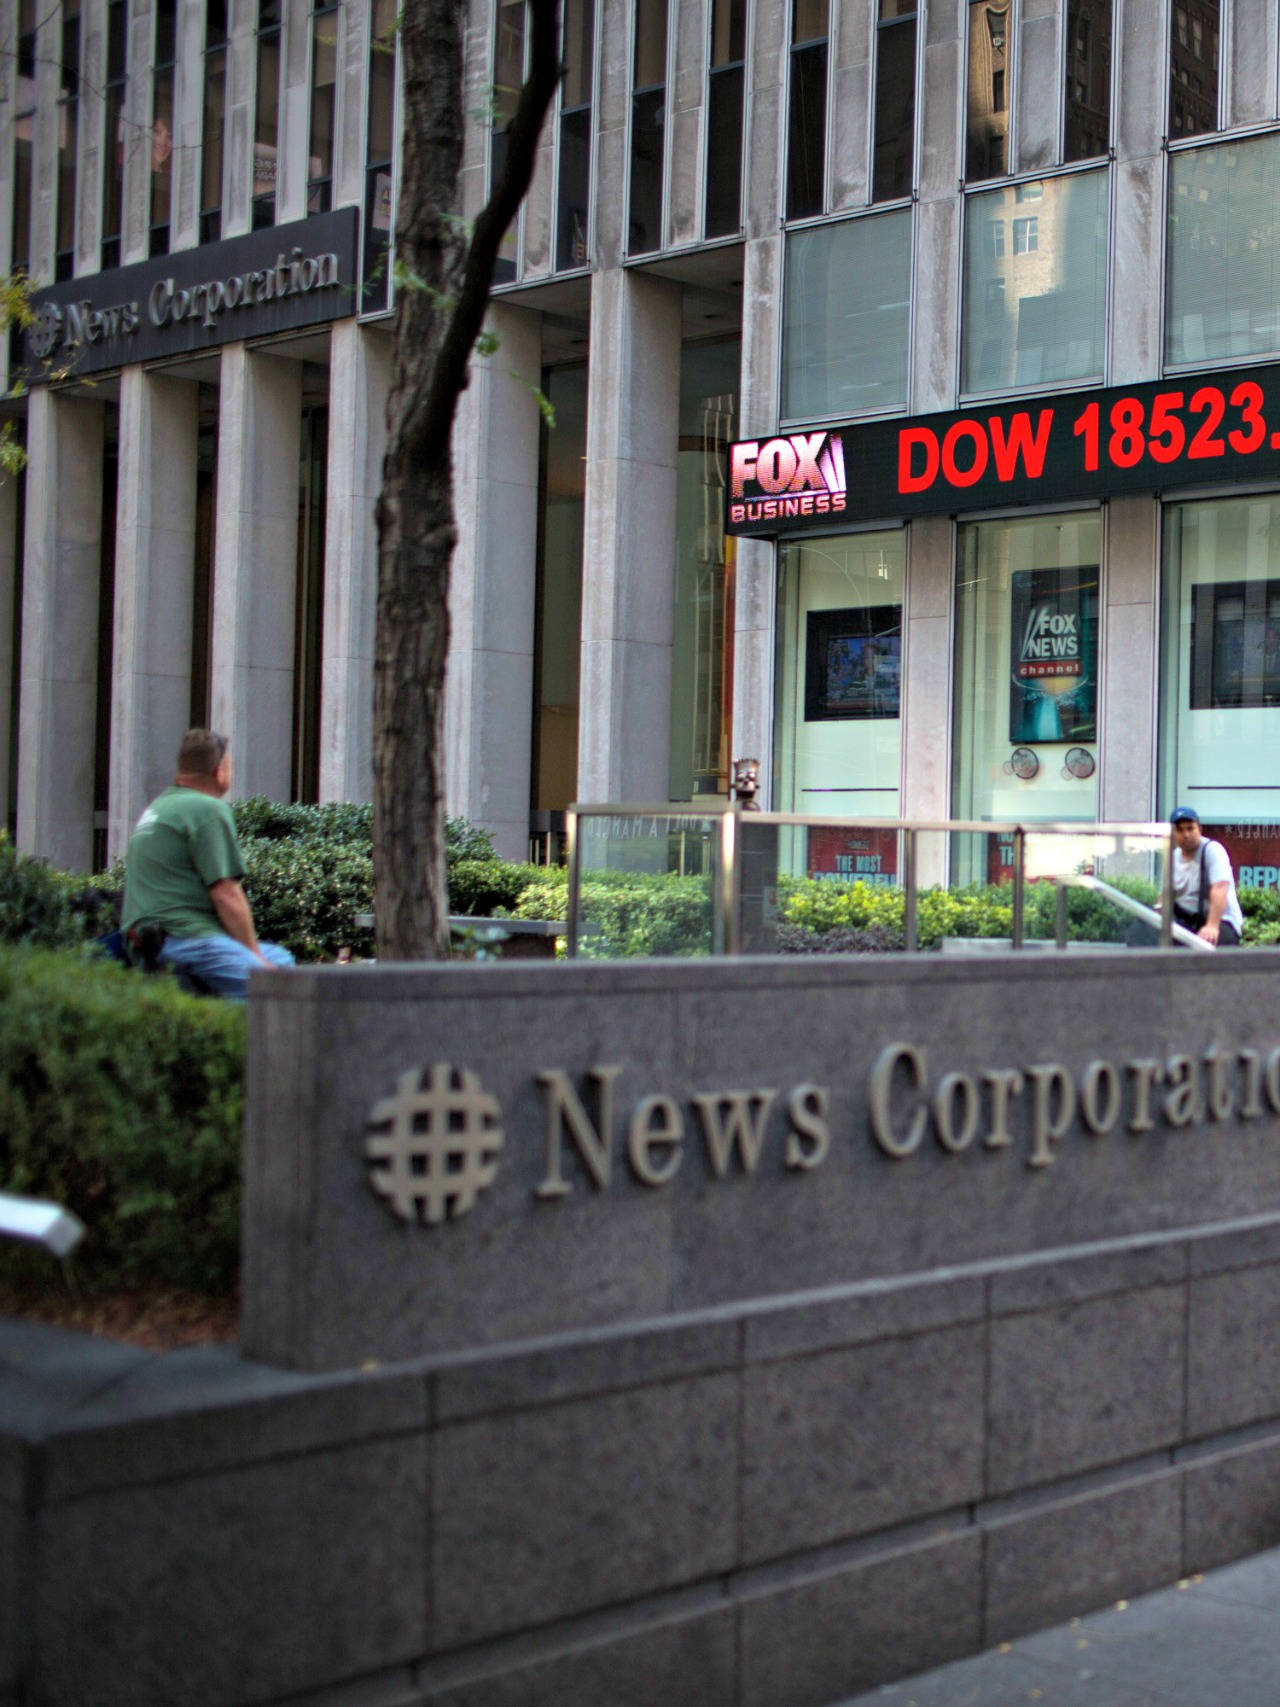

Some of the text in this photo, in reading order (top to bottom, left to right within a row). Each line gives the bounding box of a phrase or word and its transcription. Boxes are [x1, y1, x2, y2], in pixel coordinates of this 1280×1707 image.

[63, 246, 342, 346] News Corporation
[731, 431, 828, 499] FOX
[898, 409, 1053, 494] DOW
[731, 492, 847, 523] BUSINESS
[1039, 613, 1077, 636] FOX
[1028, 637, 1079, 658] NEWS
[1019, 663, 1080, 677] channel
[835, 854, 882, 872] THE MOST
[534, 1064, 831, 1198] News
